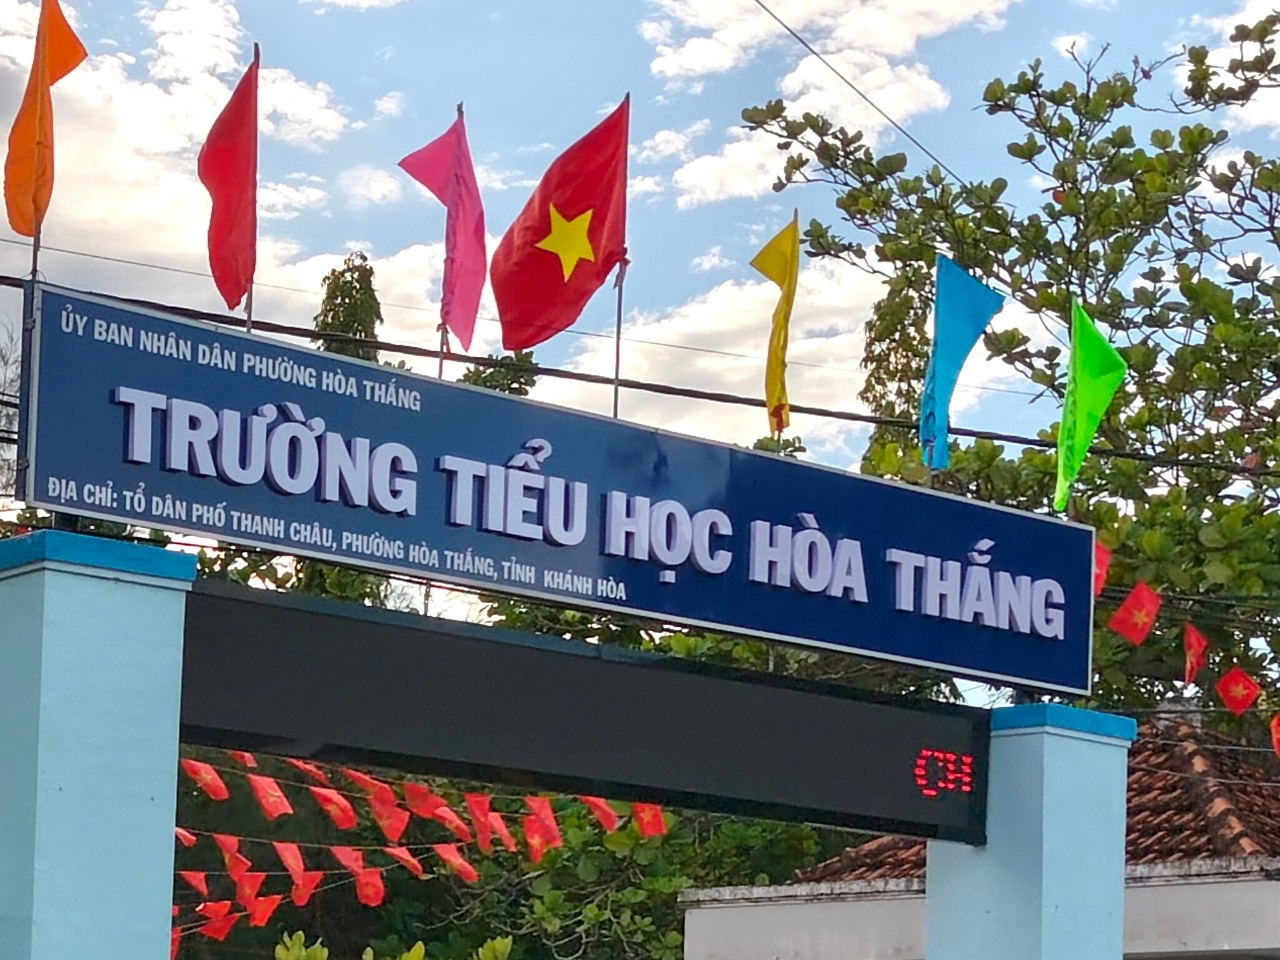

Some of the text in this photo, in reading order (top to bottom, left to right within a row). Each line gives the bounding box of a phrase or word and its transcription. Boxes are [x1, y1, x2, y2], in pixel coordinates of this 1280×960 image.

[60, 304, 421, 412] ỦY BAN NHÂN DÂN PHƯỜNG HÒA THẮNG
[48, 477, 626, 600] ĐỊA CHỈ: TỔ DÂN PHỐ THANH CHÂU, PHƯỜNG HÒA THẮNG, TỈNH KHÁNH HÒA
[116, 386, 1065, 640] TRƯỜNG TIỂU HỌC HÒA THẮNG
